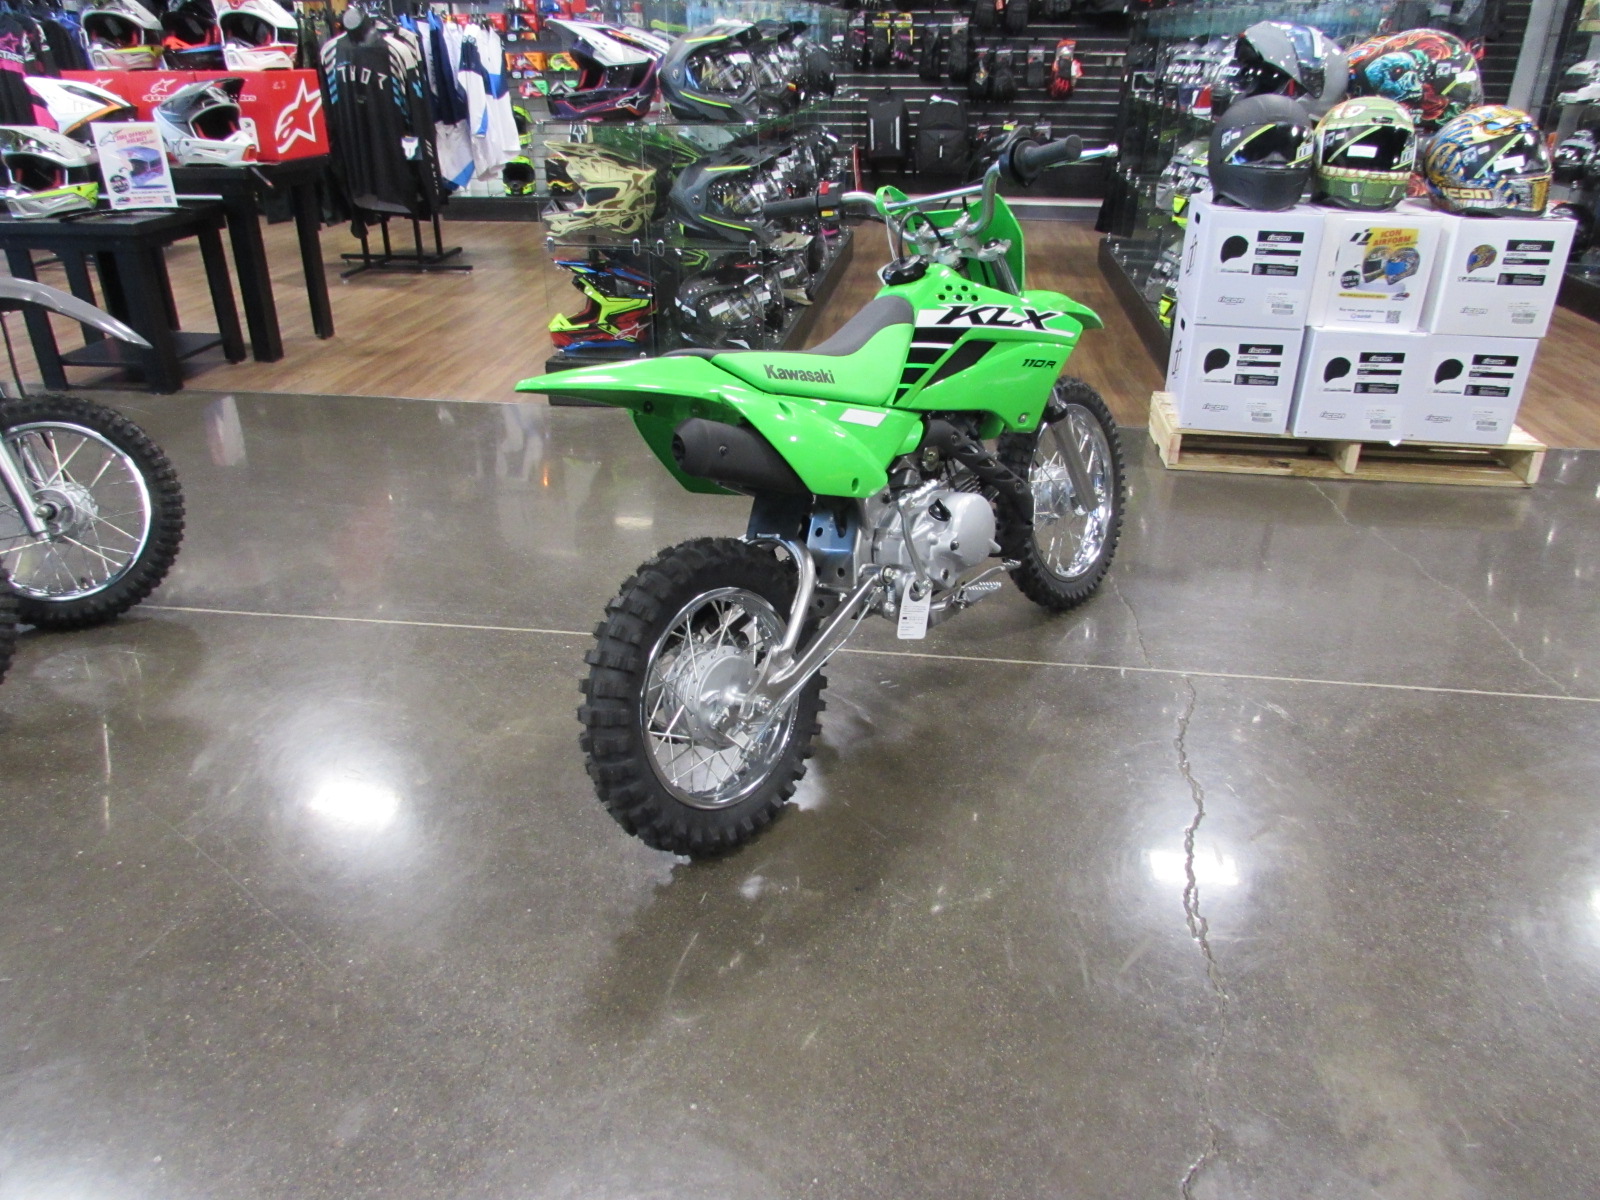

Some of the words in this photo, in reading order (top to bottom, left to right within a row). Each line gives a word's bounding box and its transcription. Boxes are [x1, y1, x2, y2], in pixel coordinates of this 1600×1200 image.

[1381, 229, 1402, 238] ICON
[1373, 236, 1412, 246] AIRFORM
[935, 304, 1062, 331] KLX
[1021, 358, 1057, 369] 110R
[763, 364, 836, 385] Kawasaki
